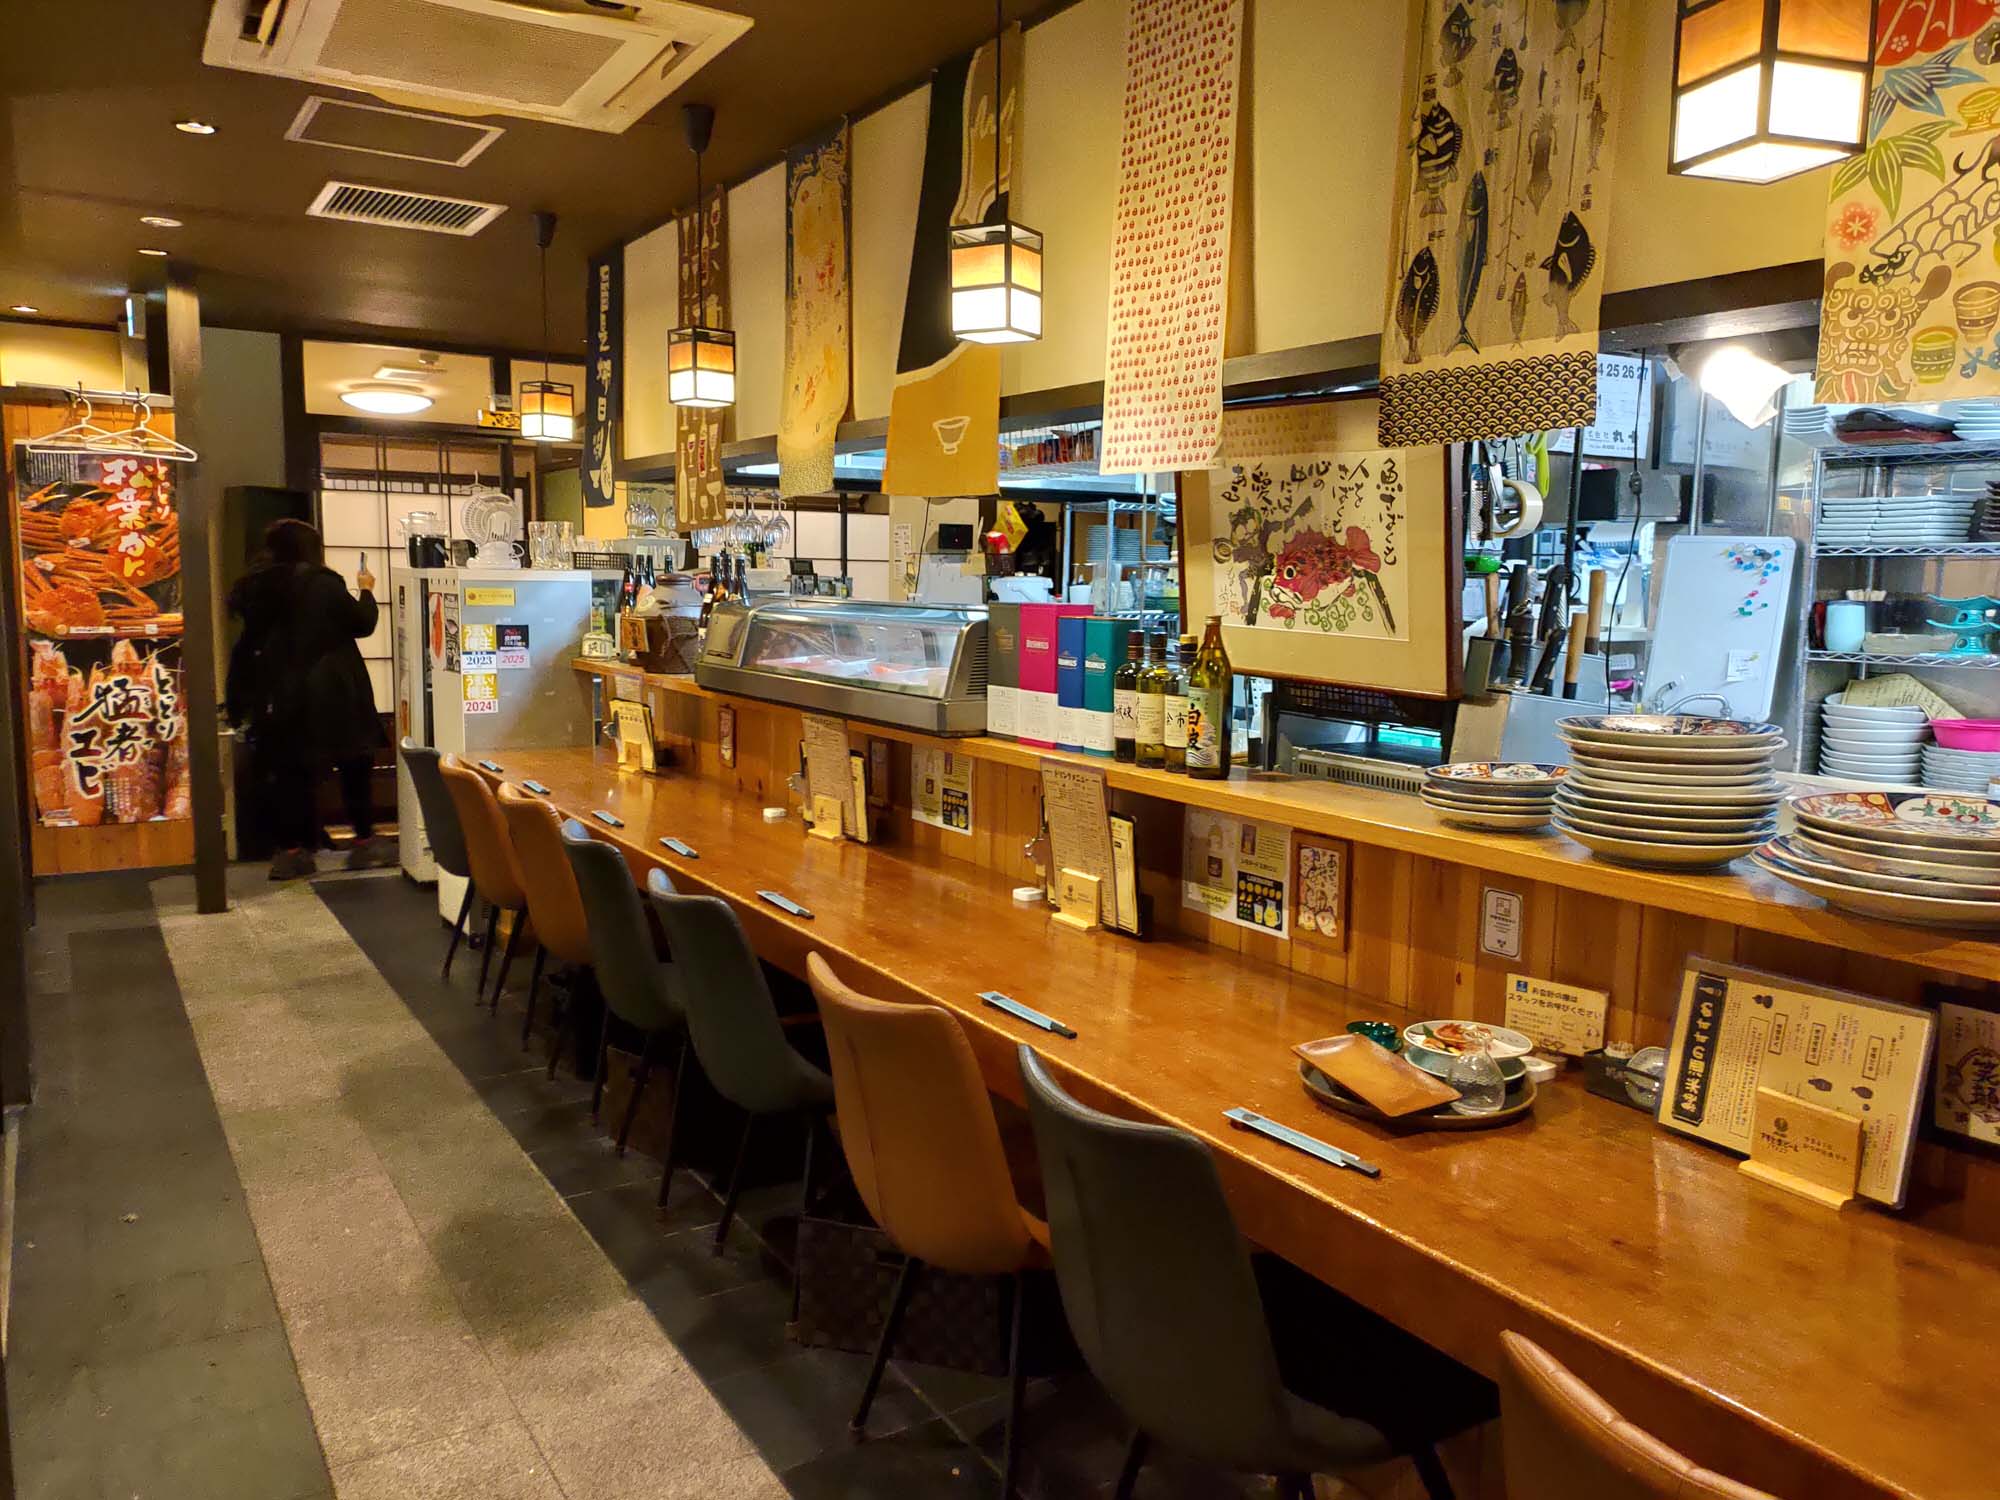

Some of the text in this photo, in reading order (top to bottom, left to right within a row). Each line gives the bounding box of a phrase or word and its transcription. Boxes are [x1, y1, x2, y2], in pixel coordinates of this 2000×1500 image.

[1606, 363, 1620, 378] 25
[1622, 365, 1635, 379] 26
[466, 655, 493, 665] 2023
[502, 655, 525, 664] 2025
[154, 665, 177, 740] とっとり
[465, 701, 493, 712] 2024
[1508, 993, 1602, 1018] スタッフをお呼びください
[1680, 1001, 1714, 1114] 純米酒のすすめ
